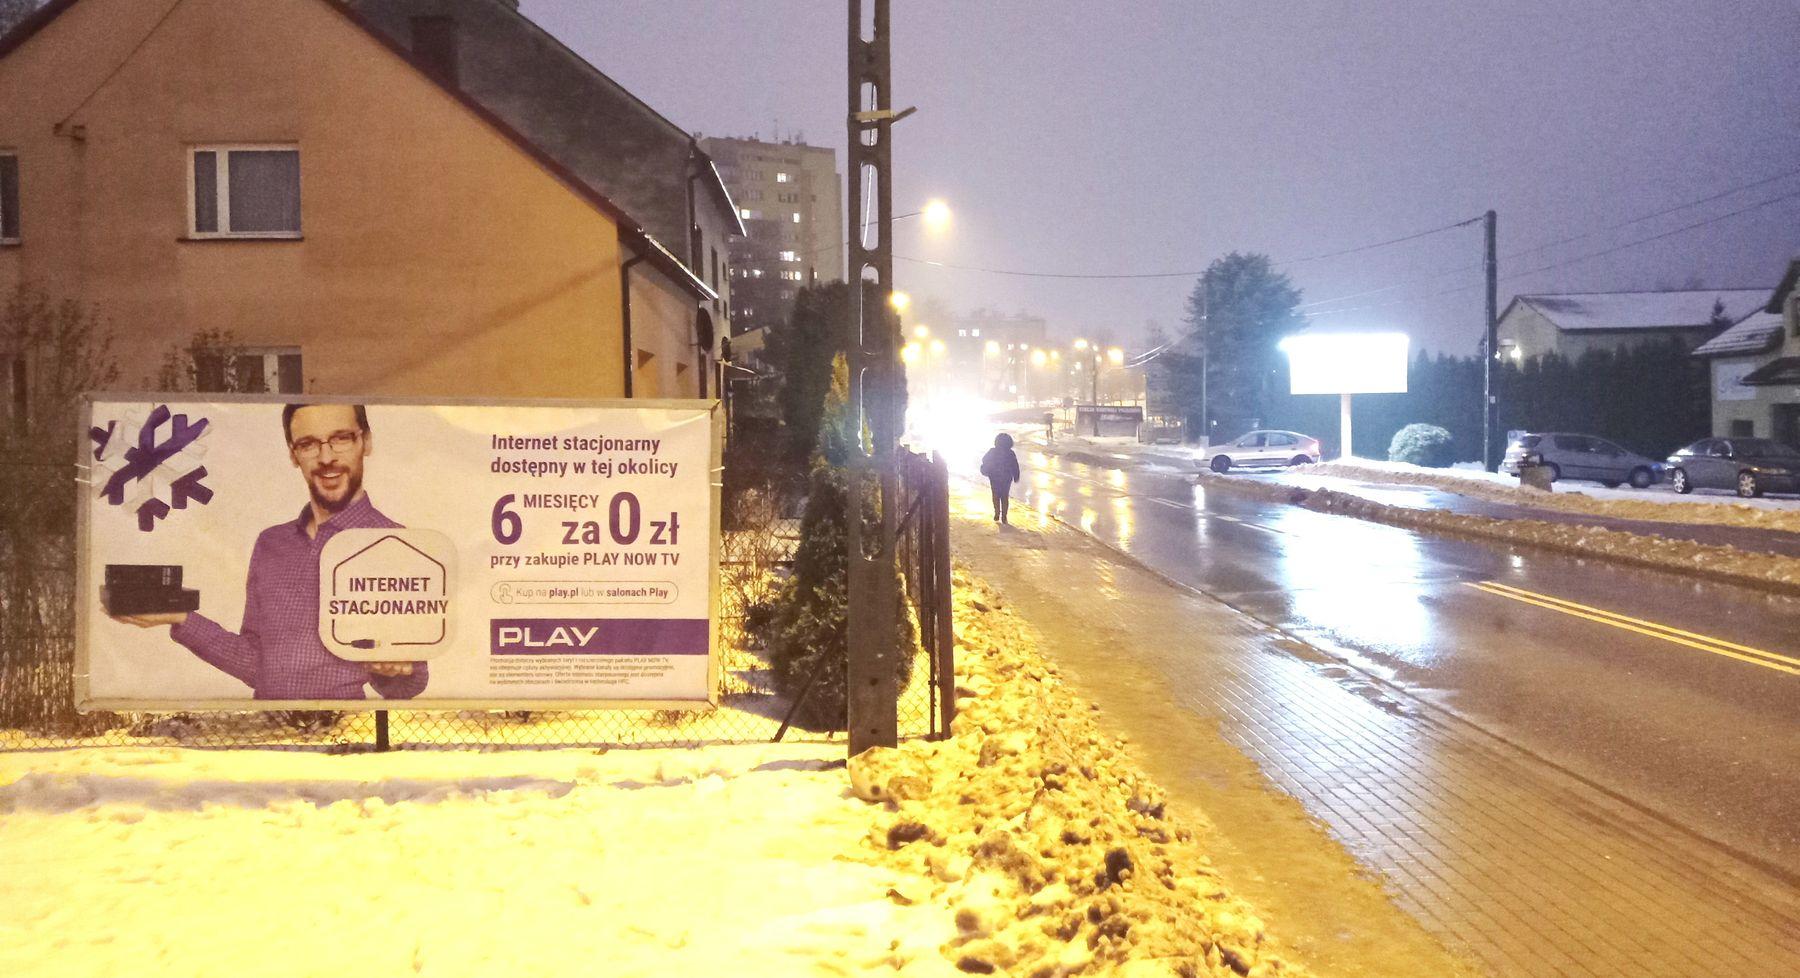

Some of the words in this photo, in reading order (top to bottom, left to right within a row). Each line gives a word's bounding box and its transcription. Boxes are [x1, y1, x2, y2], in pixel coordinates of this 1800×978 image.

[492, 434, 558, 450] Internet
[563, 436, 661, 455] stacjonarny
[491, 457, 568, 477] dostępny
[573, 461, 586, 474] w
[592, 458, 612, 478] tej
[618, 458, 678, 478] okolicy
[491, 493, 523, 545] 6
[523, 494, 599, 512] MIESIĘCY
[562, 520, 600, 545] za
[608, 491, 641, 546] 0
[649, 511, 680, 545] zł
[490, 554, 520, 569] przy
[525, 552, 579, 569] zakupie
[584, 552, 619, 566] PLAY
[624, 553, 657, 566] NOW
[661, 553, 680, 566] TV
[349, 577, 431, 592] INTERNET
[516, 588, 534, 598] Kup
[536, 589, 547, 597] na
[549, 587, 579, 598] play.pl
[581, 588, 594, 597] lub
[606, 588, 647, 597] salonach
[649, 588, 668, 599] Play
[329, 600, 449, 615] STACJONARNY
[499, 626, 599, 647] PLAY
